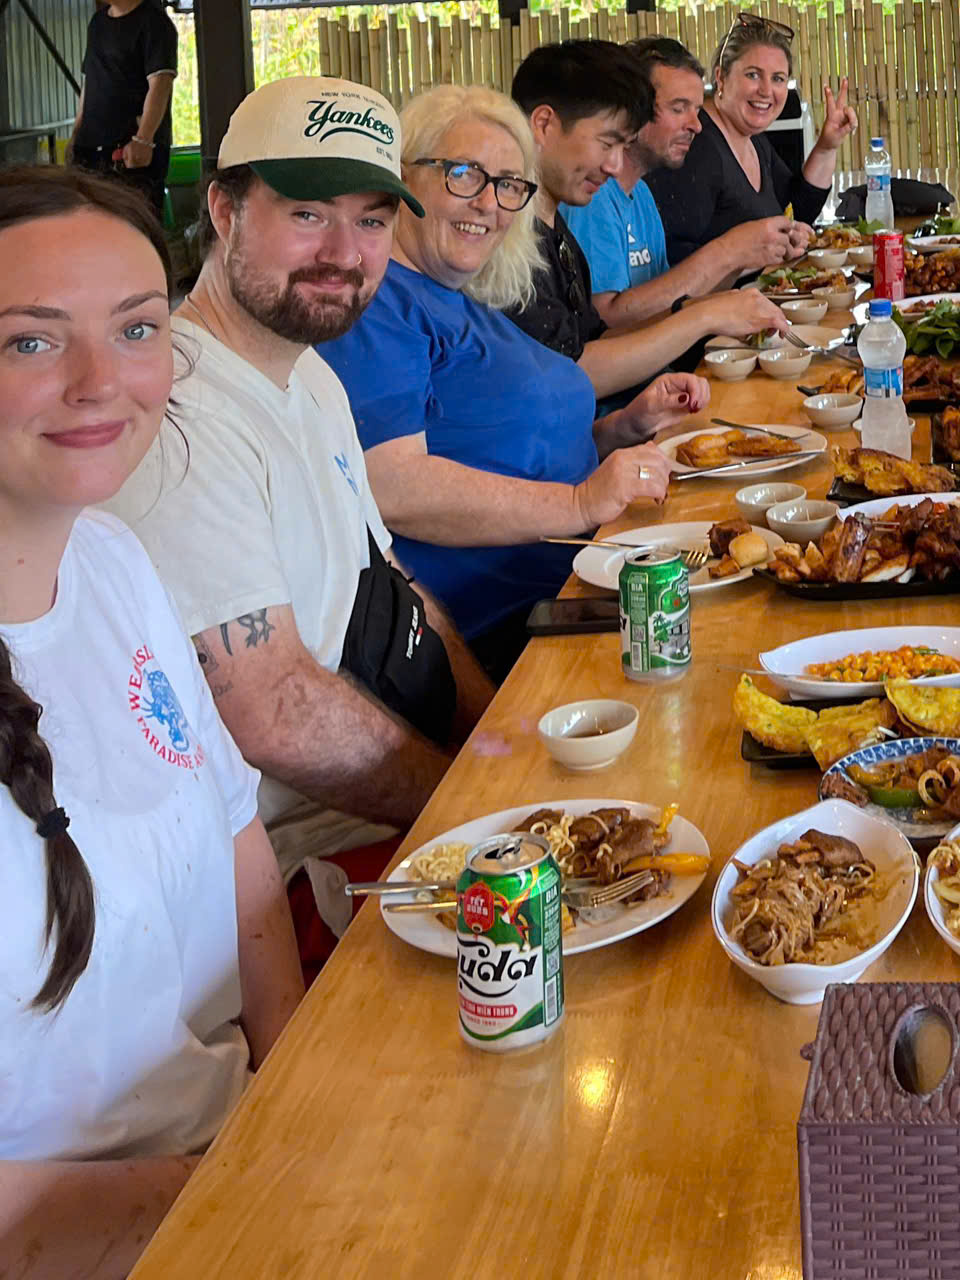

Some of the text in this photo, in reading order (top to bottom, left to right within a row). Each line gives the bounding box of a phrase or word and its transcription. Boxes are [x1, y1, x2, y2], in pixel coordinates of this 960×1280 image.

[304, 100, 394, 144] Yankees
[546, 885, 558, 904] BIA
[457, 937, 538, 983] uda
